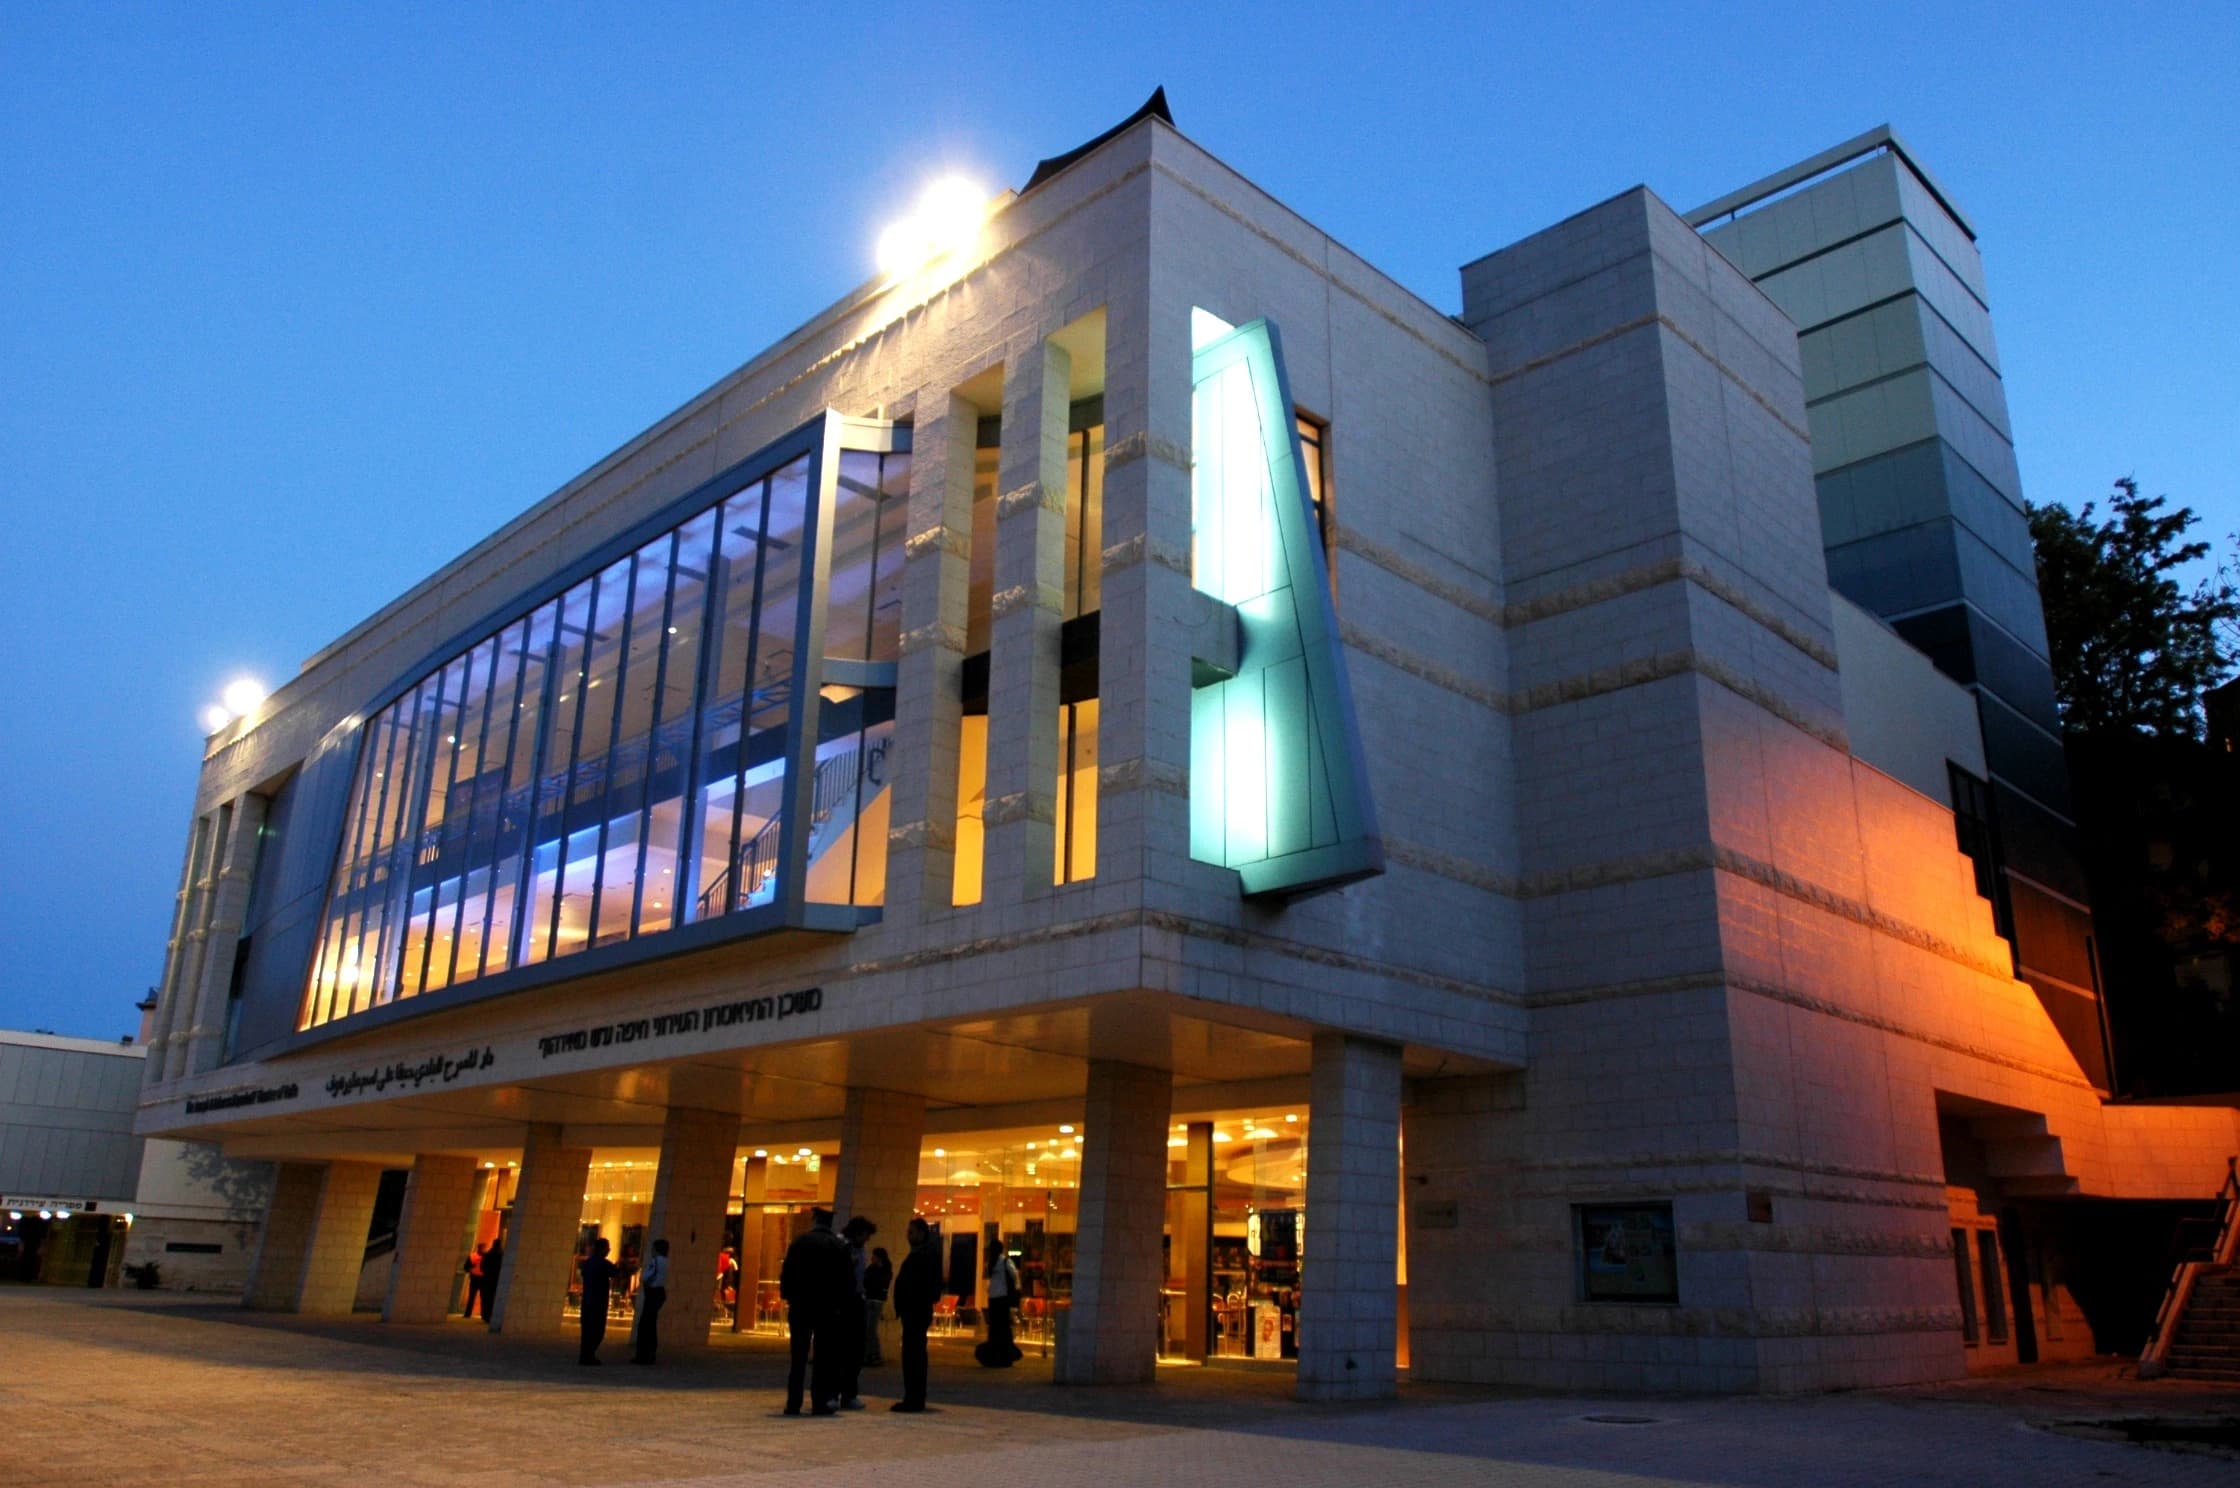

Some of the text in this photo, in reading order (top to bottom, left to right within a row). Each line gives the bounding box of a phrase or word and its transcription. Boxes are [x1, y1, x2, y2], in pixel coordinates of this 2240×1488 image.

[702, 996, 774, 1032] התיאטרון
[777, 986, 822, 1020] משכן
[615, 1020, 648, 1044] חיפה
